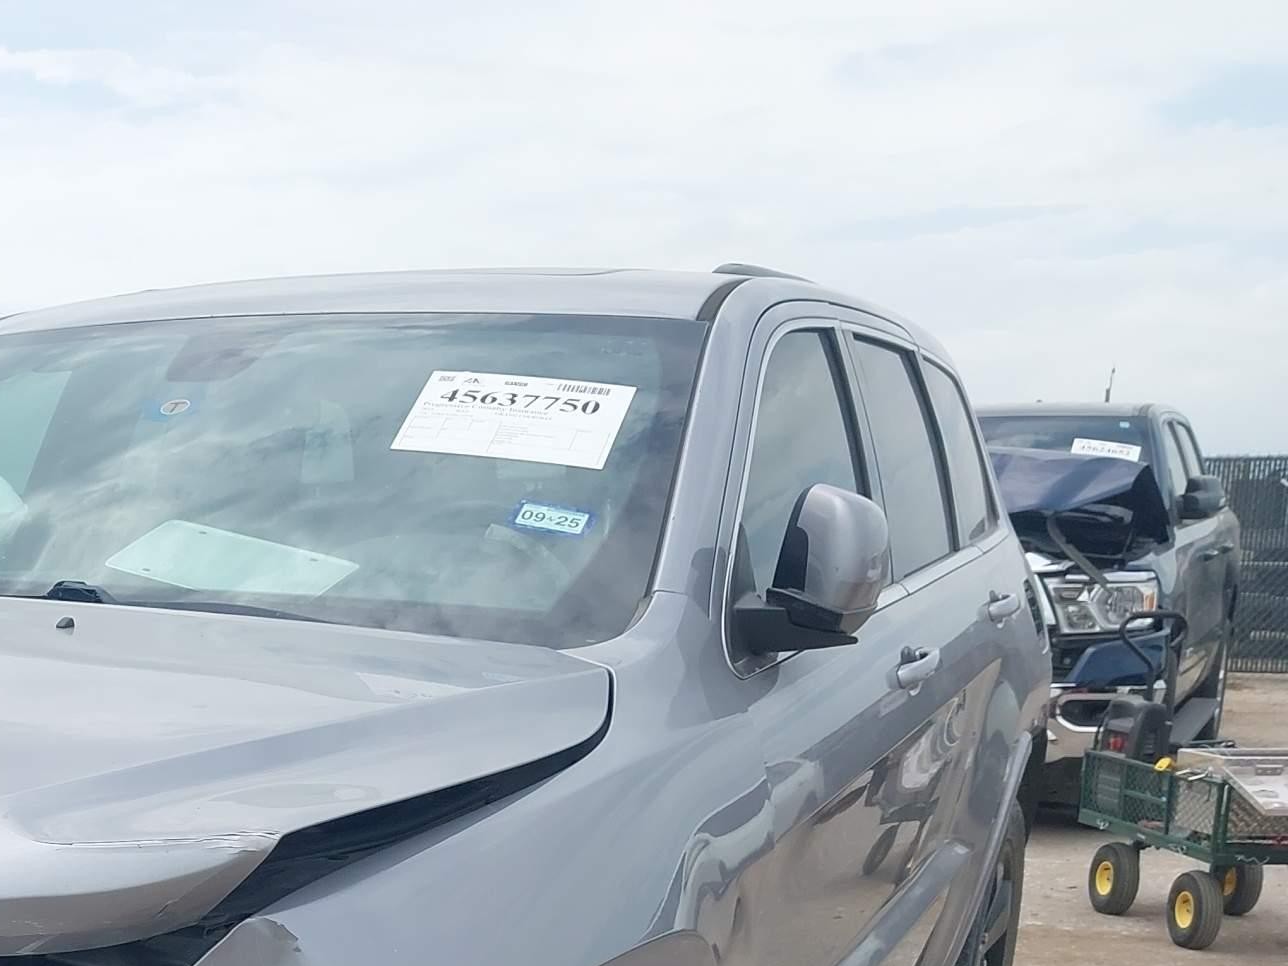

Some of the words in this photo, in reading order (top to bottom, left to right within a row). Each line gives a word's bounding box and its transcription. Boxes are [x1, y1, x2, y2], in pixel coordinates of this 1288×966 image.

[440, 386, 601, 416] 45637750
[521, 510, 546, 522] 09
[555, 516, 582, 528] 25
